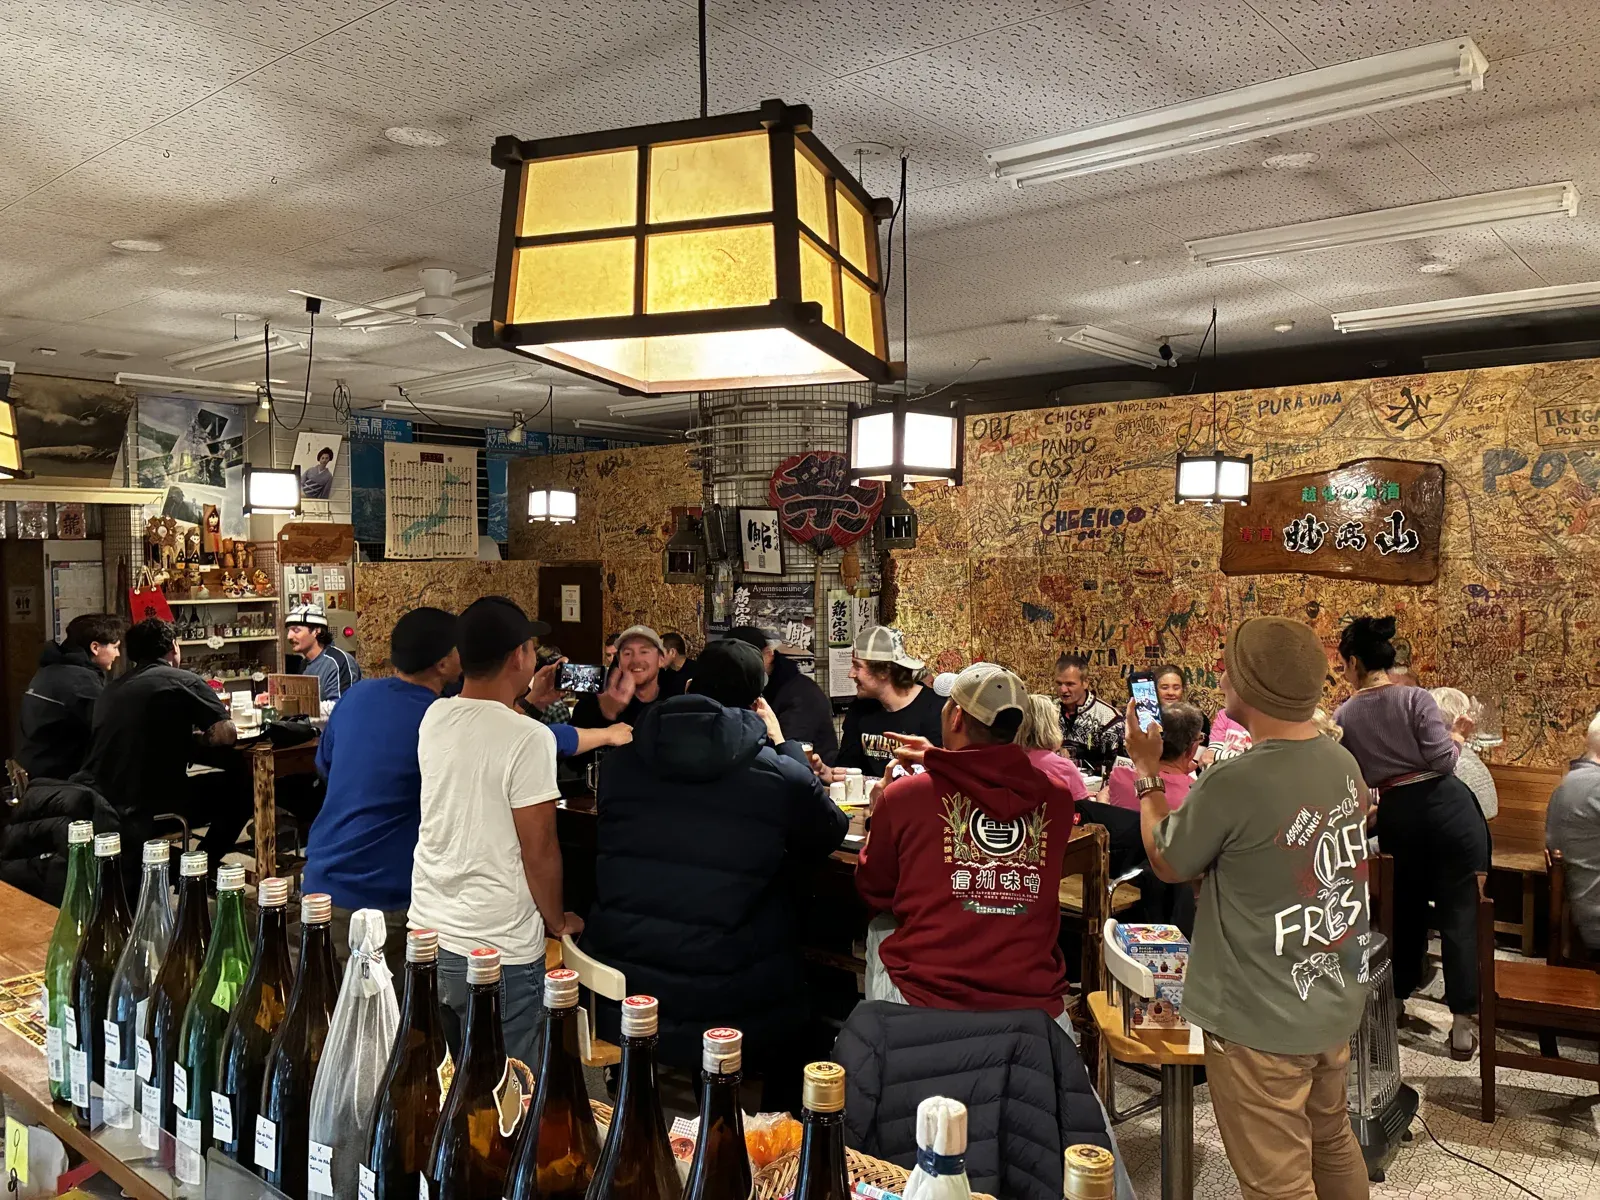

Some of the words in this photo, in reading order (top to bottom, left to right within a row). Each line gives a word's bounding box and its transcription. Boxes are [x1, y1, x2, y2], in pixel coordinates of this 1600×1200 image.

[1117, 401, 1167, 414] NAPOLEON
[1257, 397, 1304, 418] PURA
[1310, 391, 1342, 406] VIDA
[1044, 407, 1107, 425] CHICKEN
[973, 414, 1015, 441] OBI
[1065, 420, 1092, 434] DOG
[1041, 437, 1097, 457] PANDO
[1028, 456, 1075, 479] CASS
[1015, 480, 1060, 501] DEAN
[1010, 500, 1059, 515] MARTY
[1040, 505, 1147, 535] CHEEHOO
[951, 870, 1041, 894] 信州味噌
